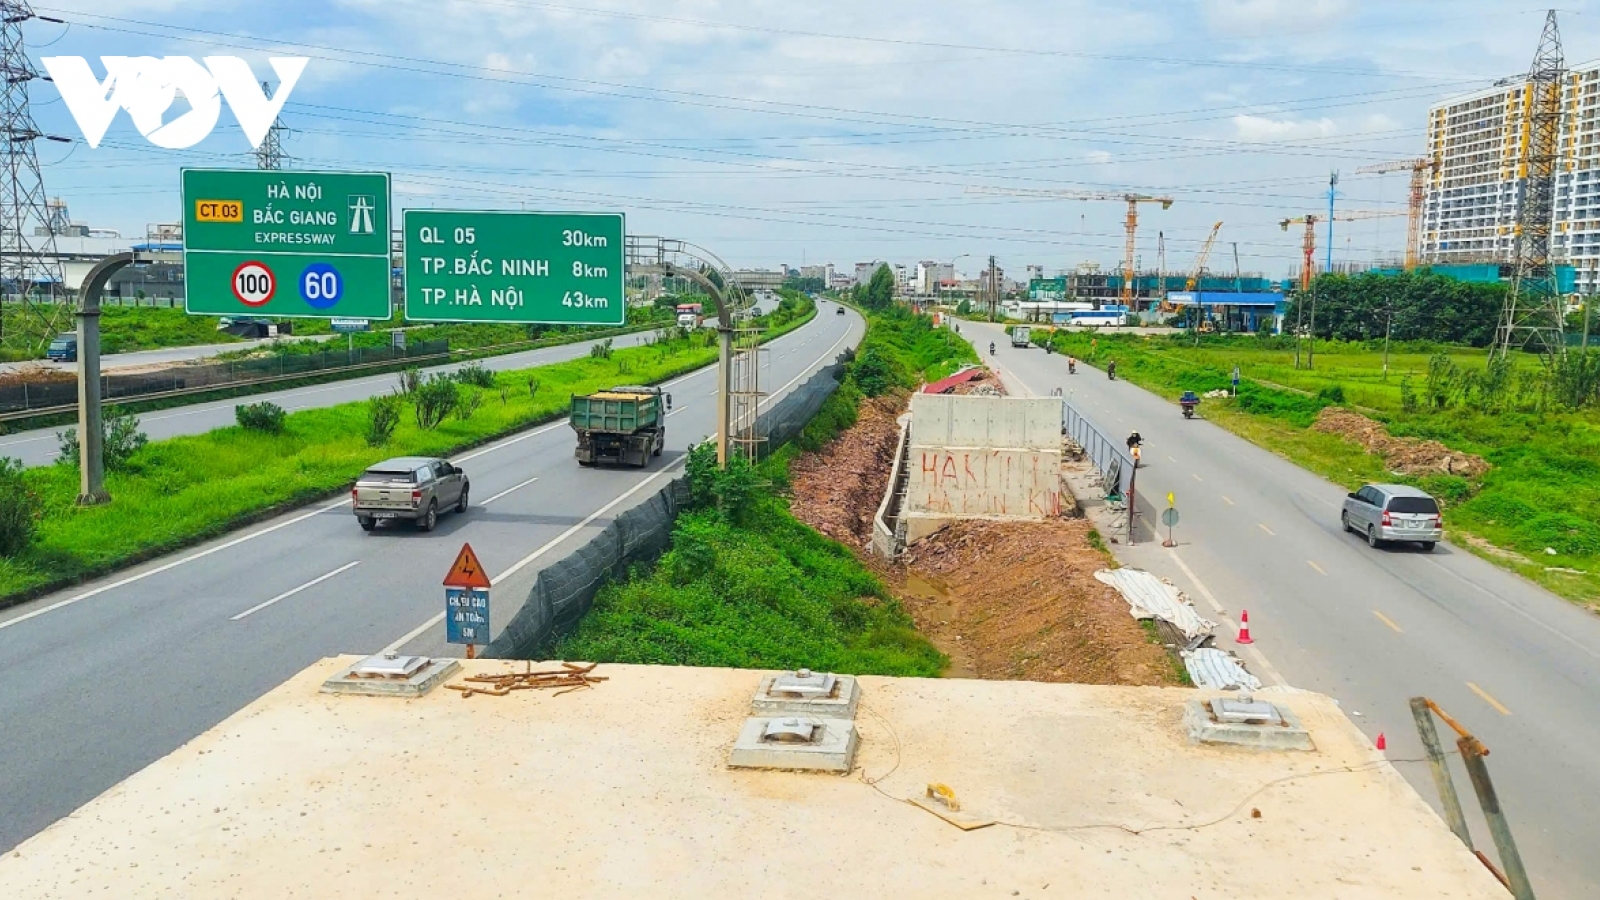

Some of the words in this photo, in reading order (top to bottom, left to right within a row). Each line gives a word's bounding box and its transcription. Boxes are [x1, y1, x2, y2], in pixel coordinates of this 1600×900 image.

[267, 180, 290, 199] HÀ
[295, 181, 322, 203] NỘI
[253, 203, 284, 224] BẮC
[290, 211, 337, 225] GIANG
[255, 232, 335, 244] EXPRESSWAY
[420, 226, 444, 244] QL
[454, 227, 475, 244] 05
[562, 230, 607, 247] 30km
[420, 250, 493, 276] TP.BẮC
[502, 259, 549, 276] NINH
[572, 261, 608, 278] 8km
[239, 274, 269, 294] 100
[305, 271, 337, 299] 60
[420, 284, 482, 306] TP.HÀ
[491, 286, 523, 310] NỘI
[561, 291, 608, 308] 43km
